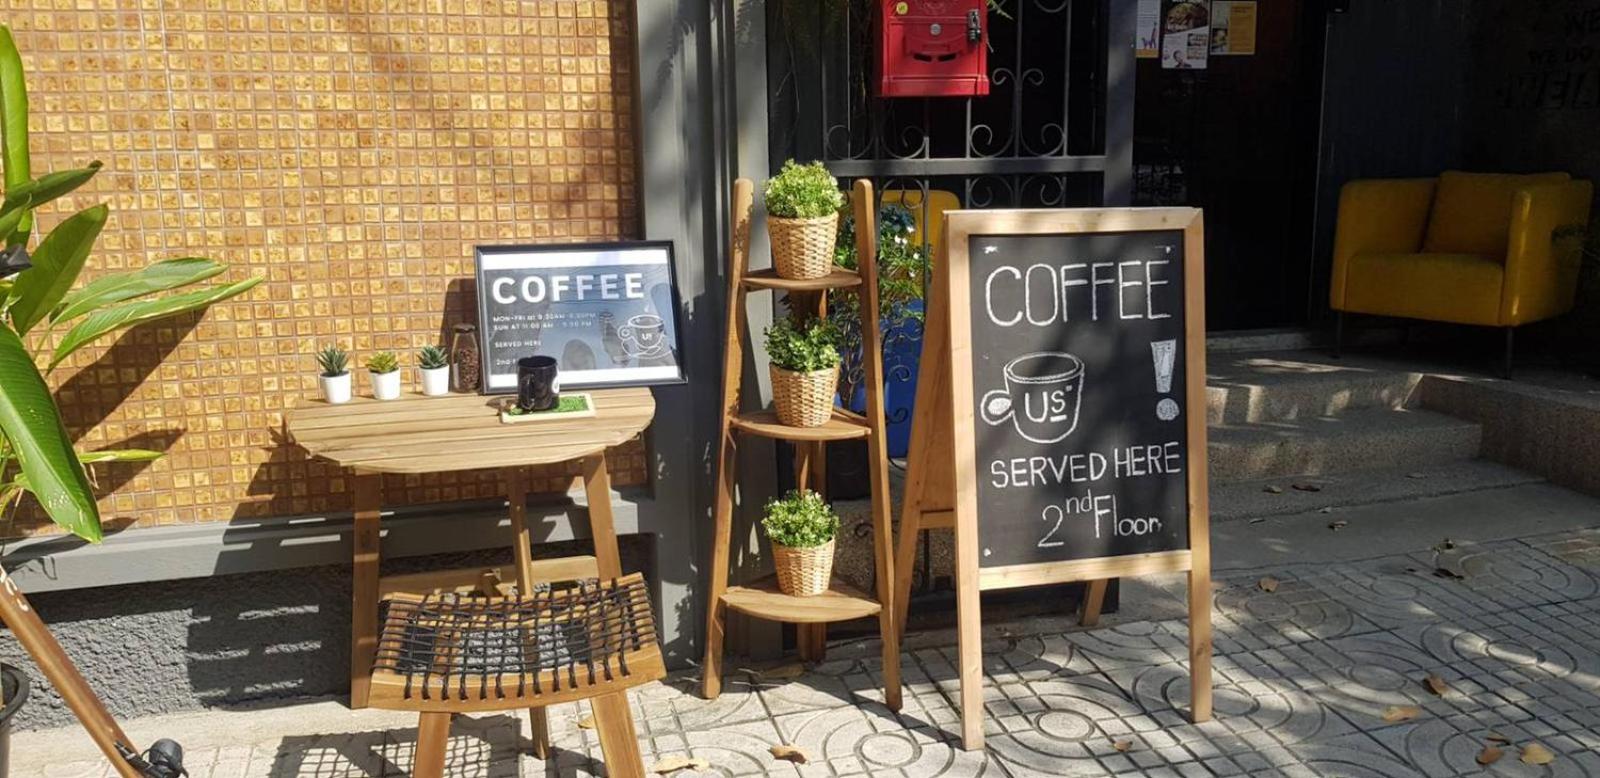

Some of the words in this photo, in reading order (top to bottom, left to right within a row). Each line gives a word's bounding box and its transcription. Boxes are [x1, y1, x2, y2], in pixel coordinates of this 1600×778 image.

[492, 272, 645, 305] COFFEE
[985, 259, 1172, 326] COFFEE
[991, 452, 1107, 488] SERVED
[1114, 441, 1181, 478] HERE
[1037, 488, 1093, 548] 2nd
[1093, 493, 1161, 539] Floor
